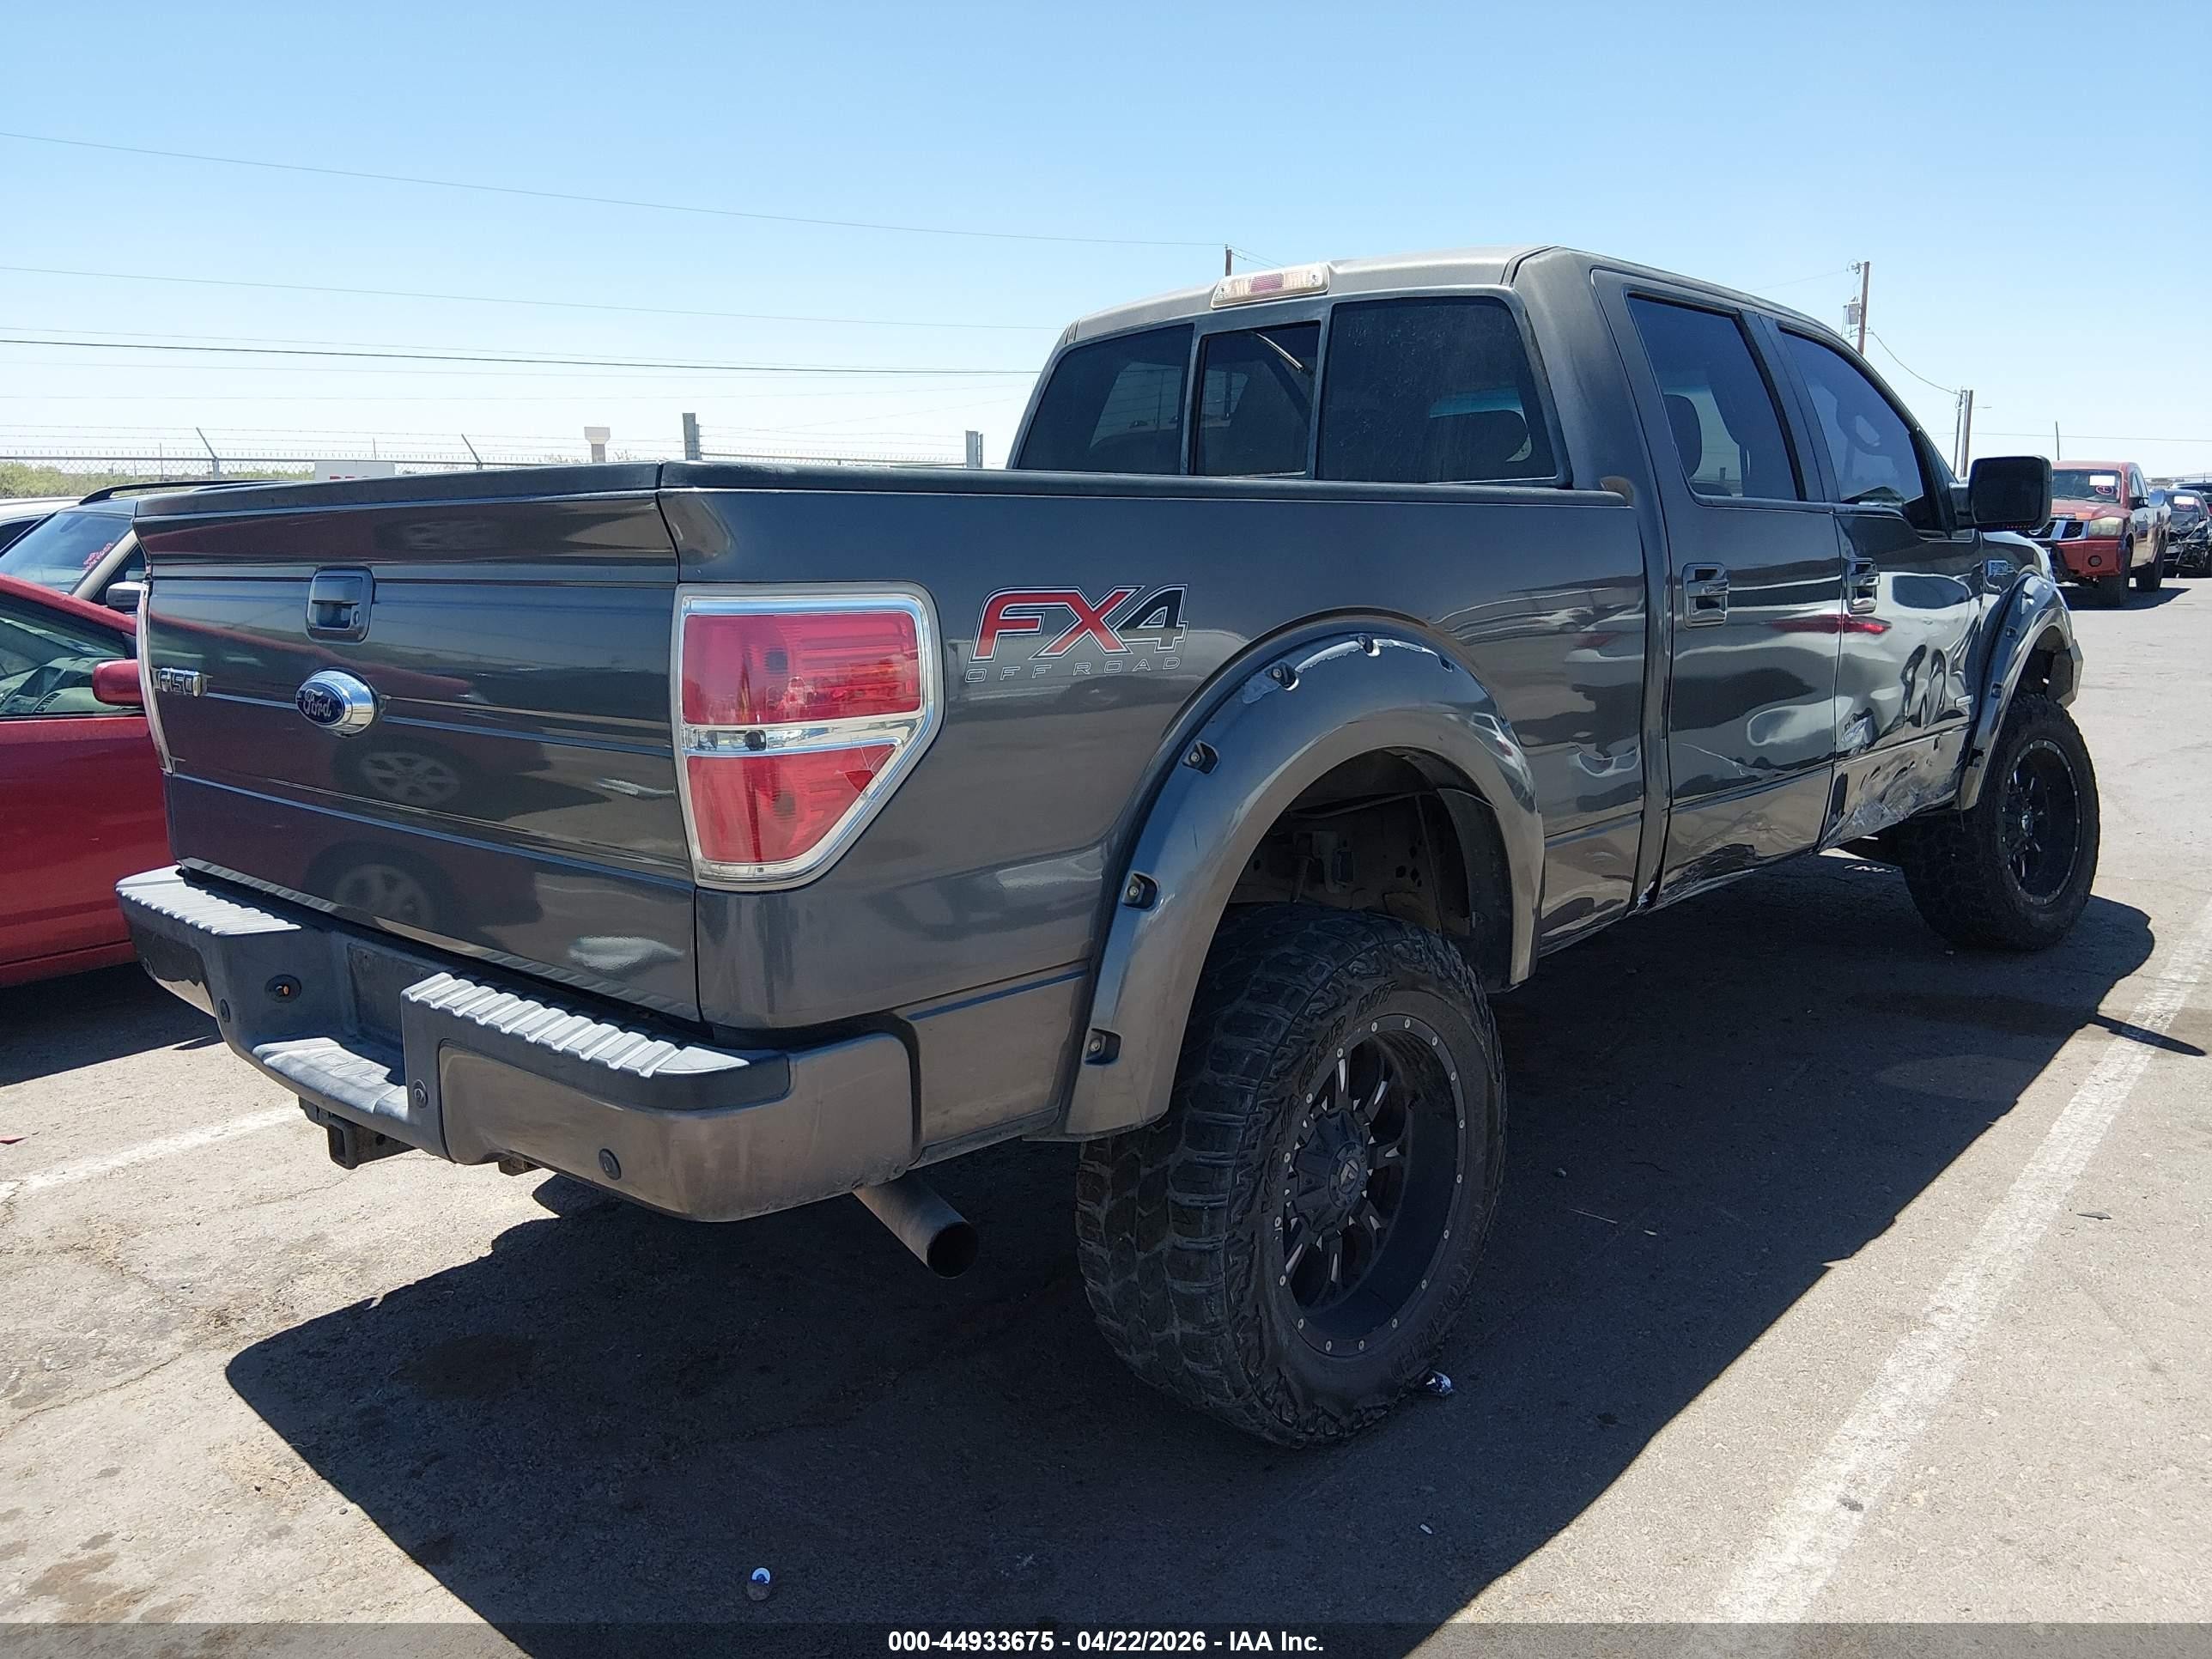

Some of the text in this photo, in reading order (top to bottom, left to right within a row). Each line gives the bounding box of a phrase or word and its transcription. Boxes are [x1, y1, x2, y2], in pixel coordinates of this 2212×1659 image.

[969, 584, 1188, 663] FX4
[964, 657, 1182, 684] OFF ROAD
[302, 688, 332, 718] Ford
